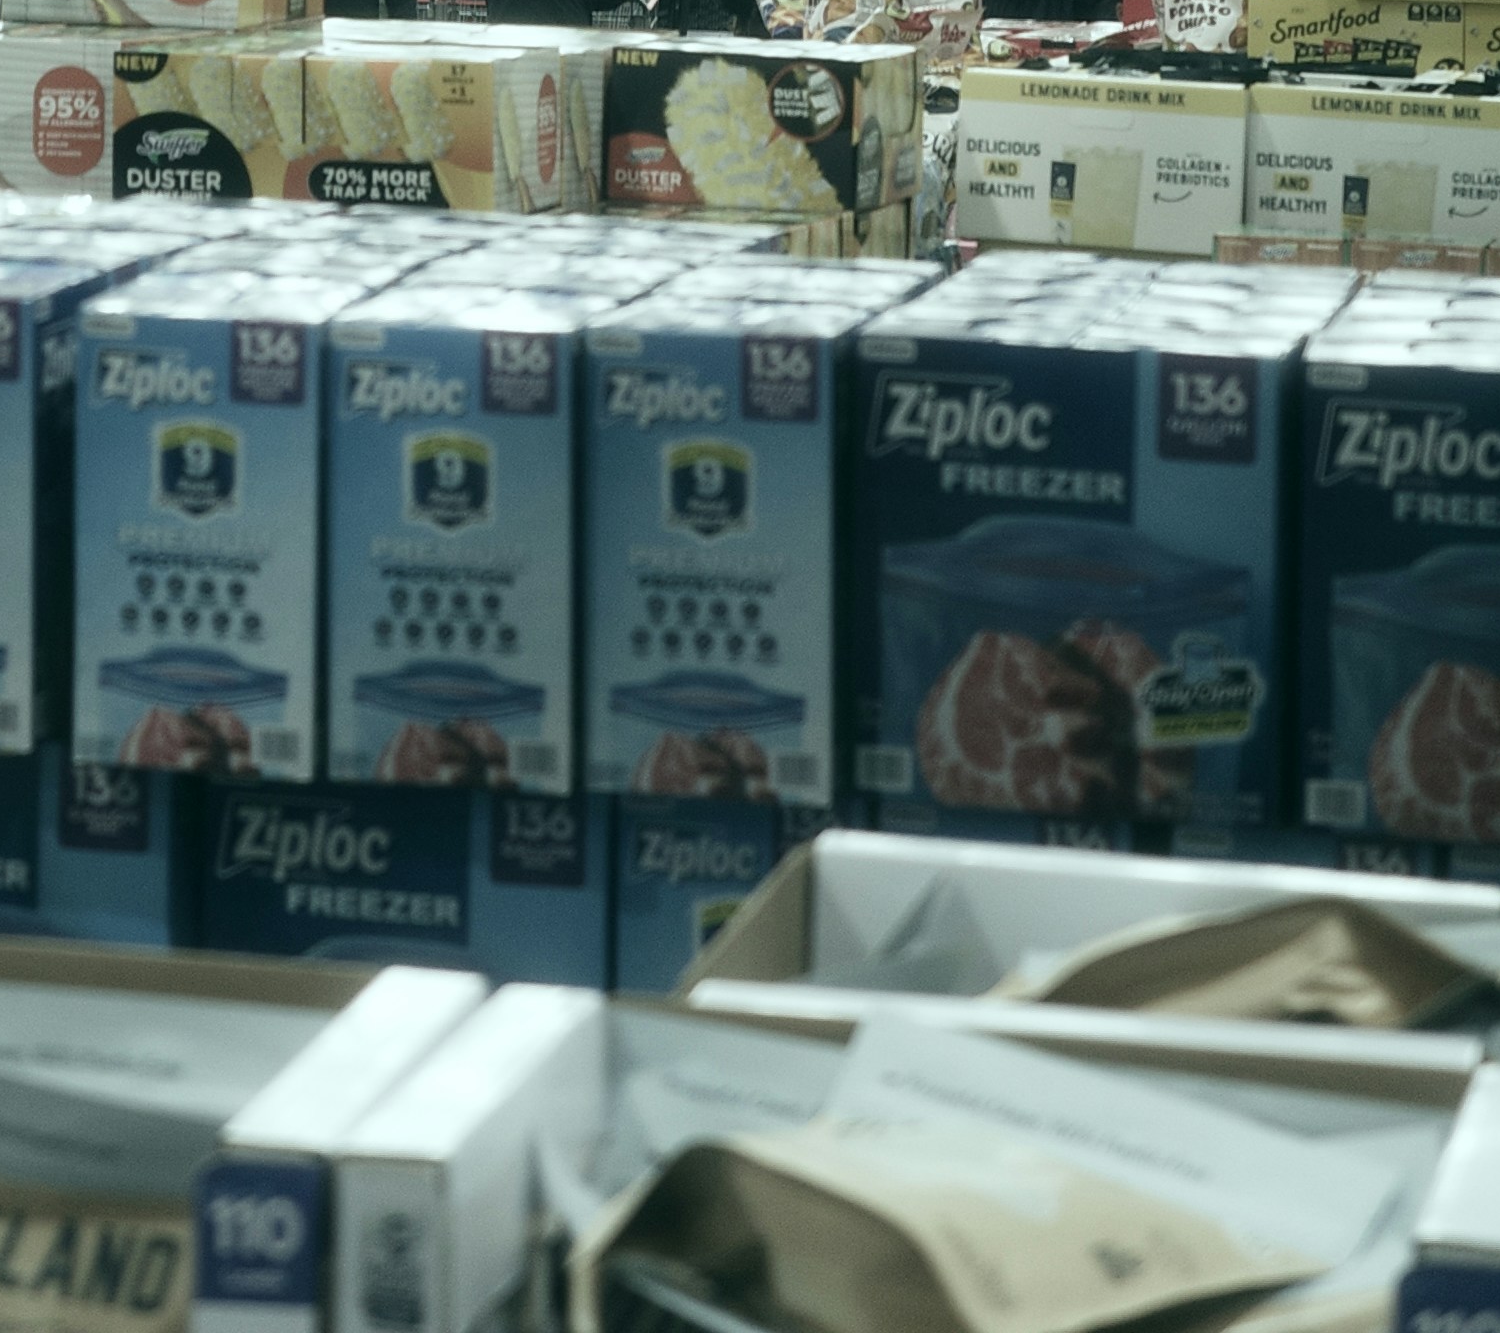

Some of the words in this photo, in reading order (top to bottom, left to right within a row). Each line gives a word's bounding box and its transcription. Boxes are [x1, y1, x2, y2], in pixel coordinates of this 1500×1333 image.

[1169, 4, 1231, 19] POTATO
[1270, 5, 1381, 44] Smartfood
[116, 55, 159, 71] NEW
[615, 49, 659, 67] NEW
[774, 88, 807, 101] DUST
[1020, 82, 1100, 102] LEMONADE
[1106, 88, 1151, 105] DRINK
[1158, 90, 1186, 108] MIX
[39, 96, 99, 119] 95%
[1312, 96, 1394, 115] LEMONADE
[1400, 102, 1447, 119] DRINK
[1452, 106, 1482, 121] MIX
[965, 138, 1042, 157] DELICIOUS
[988, 161, 1018, 177] AND
[1156, 158, 1222, 174] COLLAGEN
[1256, 153, 1334, 172] DELICIOUS
[127, 169, 221, 190] DUSTER
[323, 167, 367, 186] 70%
[372, 169, 432, 187] MORE
[615, 168, 682, 188] DUSTER
[1155, 170, 1231, 189] PREBIOTICS
[1277, 175, 1310, 192] AND
[323, 183, 364, 200] TRAP
[366, 185, 379, 199] &
[383, 185, 431, 201] LOCK
[968, 181, 1036, 200] HEALTHY!
[1258, 195, 1328, 214] HEALTHY!
[235, 327, 296, 359] 136
[490, 338, 551, 373] 136
[748, 341, 810, 380] 136
[99, 354, 217, 408] Ziploc
[349, 369, 467, 421] Ziploc
[607, 374, 728, 426] Ziploc
[1172, 372, 1248, 415] 136
[883, 383, 1052, 458] Ziploc
[940, 463, 1127, 505] FREEZER
[235, 808, 390, 881] Ziploc
[638, 831, 755, 881] Ziploc
[286, 885, 460, 928] FREEZER
[205, 1196, 305, 1256] 110
